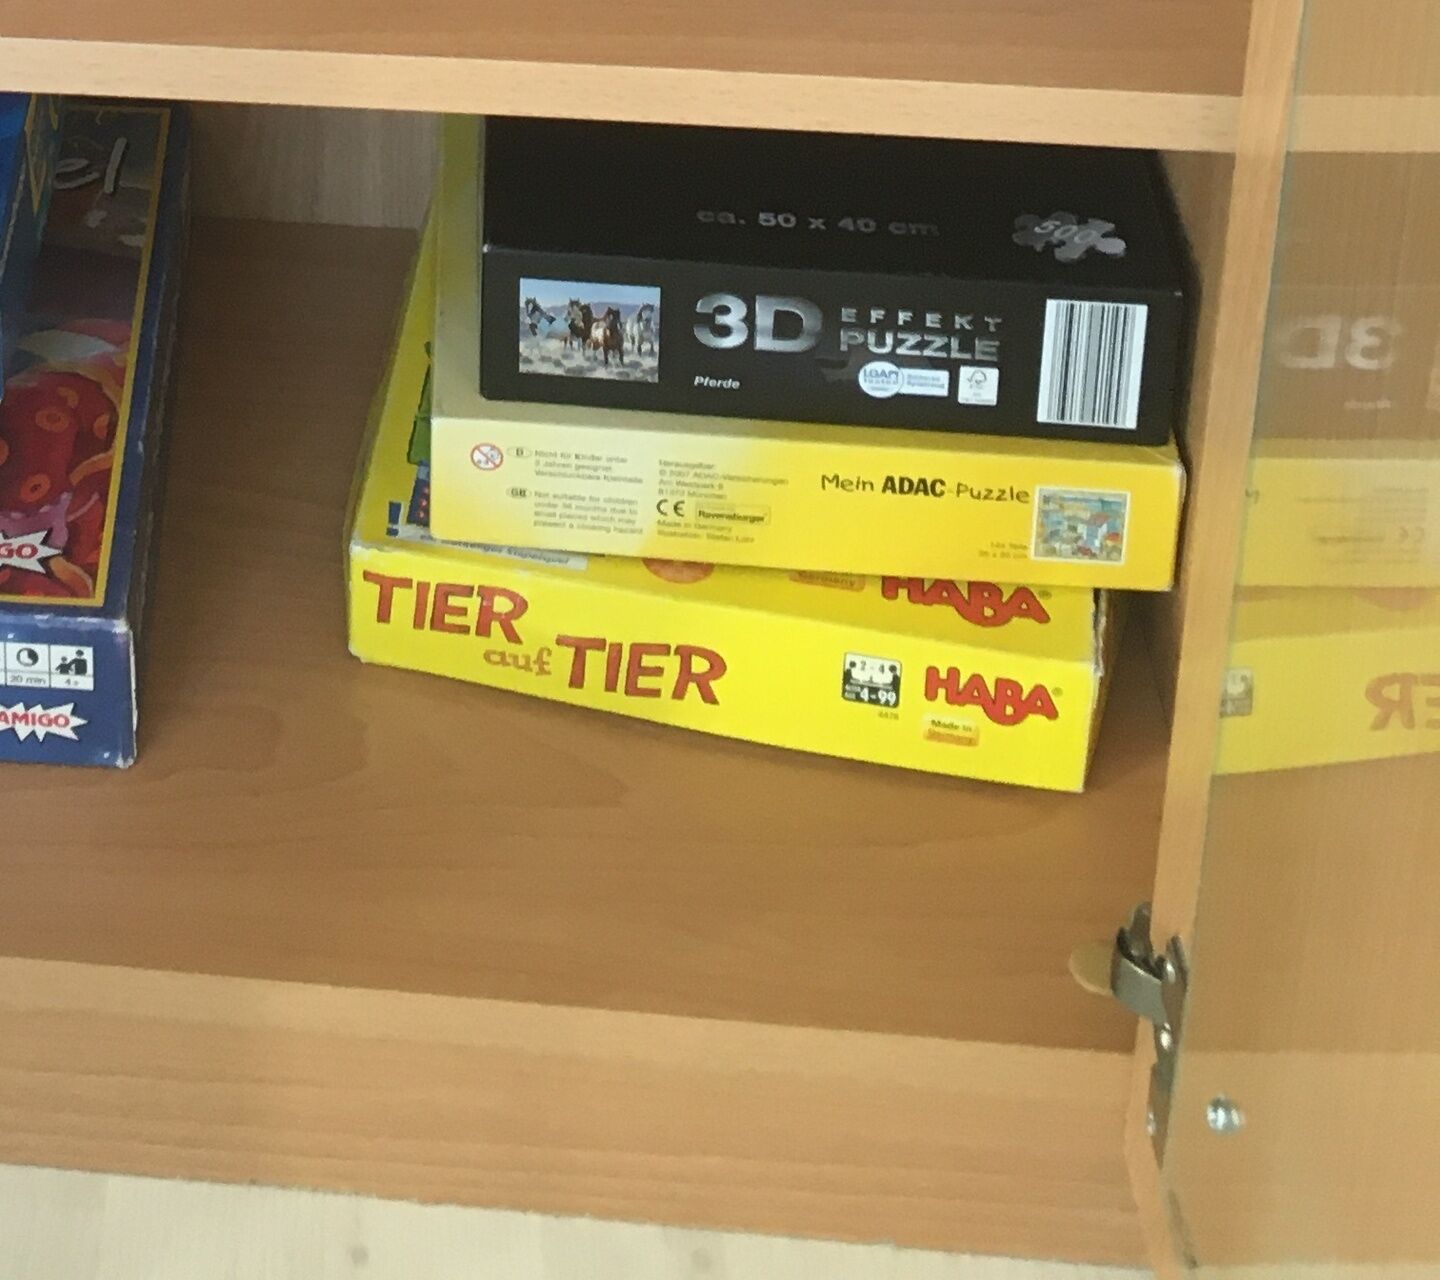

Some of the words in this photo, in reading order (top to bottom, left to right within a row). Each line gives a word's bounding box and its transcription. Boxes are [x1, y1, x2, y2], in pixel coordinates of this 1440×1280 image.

[758, 212, 796, 229] 50
[692, 292, 827, 355] 3D
[841, 307, 1003, 332] EFFEKT
[840, 328, 1001, 362] PUZZLE
[693, 375, 742, 391] Pferde
[821, 473, 875, 493] Mein
[363, 570, 529, 645] TIER
[880, 575, 1051, 627] HABA
[483, 646, 553, 676] auf
[556, 634, 728, 705] TIER
[925, 665, 1059, 726] HABA
